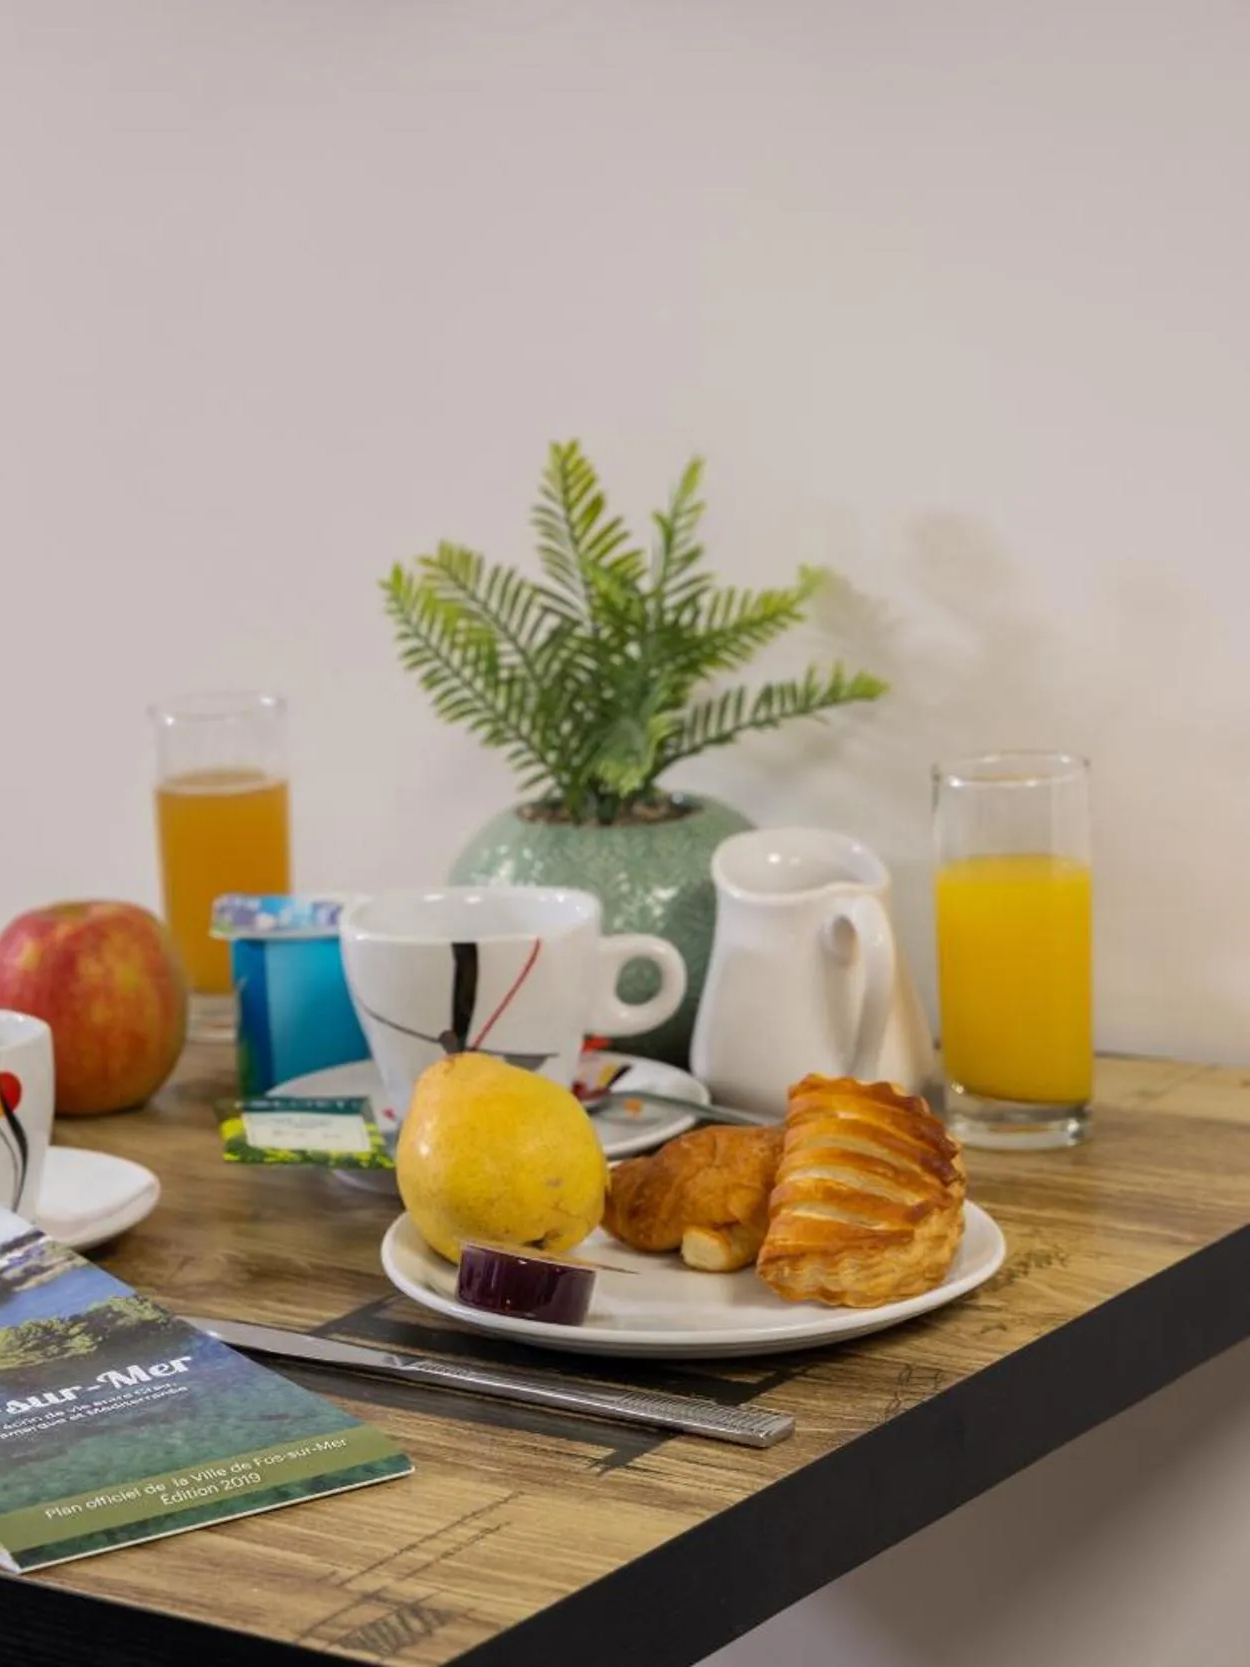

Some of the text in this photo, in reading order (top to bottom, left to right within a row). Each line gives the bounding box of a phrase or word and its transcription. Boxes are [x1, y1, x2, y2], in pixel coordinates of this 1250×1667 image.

[45, 1438, 348, 1521] Plan officiel de la Ville de Fos-sur-Mer
[220, 1472, 262, 1491] 2019
